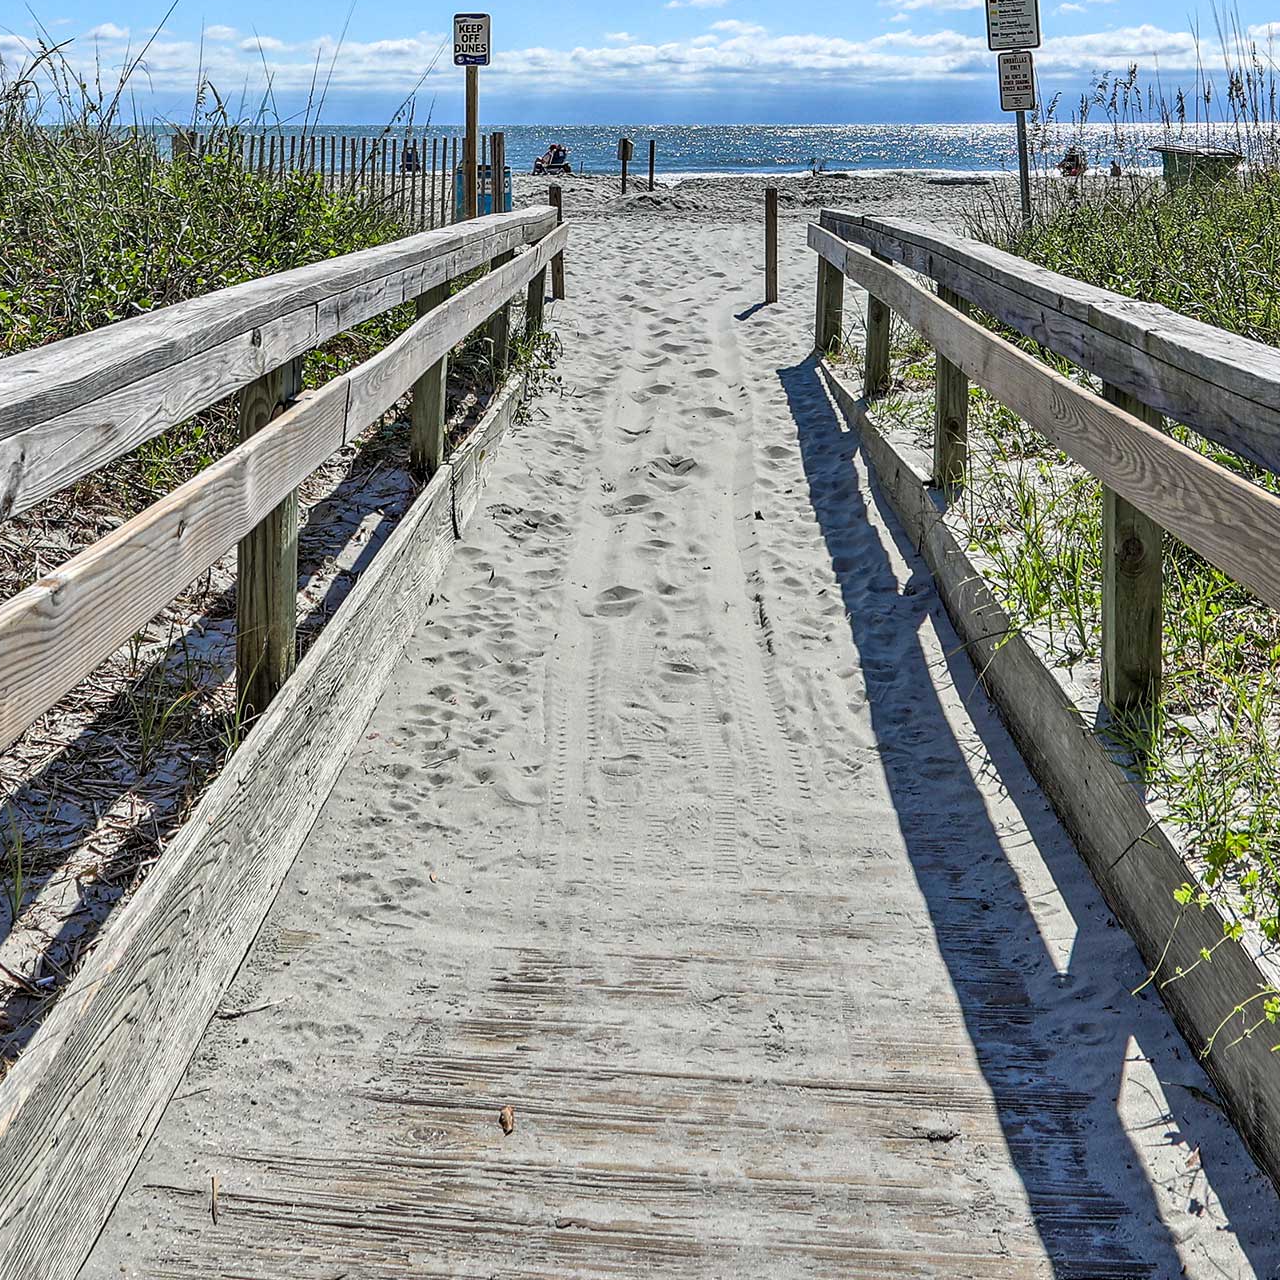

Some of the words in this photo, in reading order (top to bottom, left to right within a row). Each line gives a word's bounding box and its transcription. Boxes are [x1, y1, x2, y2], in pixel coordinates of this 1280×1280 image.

[459, 24, 483, 33] KEEP
[461, 34, 480, 43] OFF
[455, 43, 487, 53] DUNES
